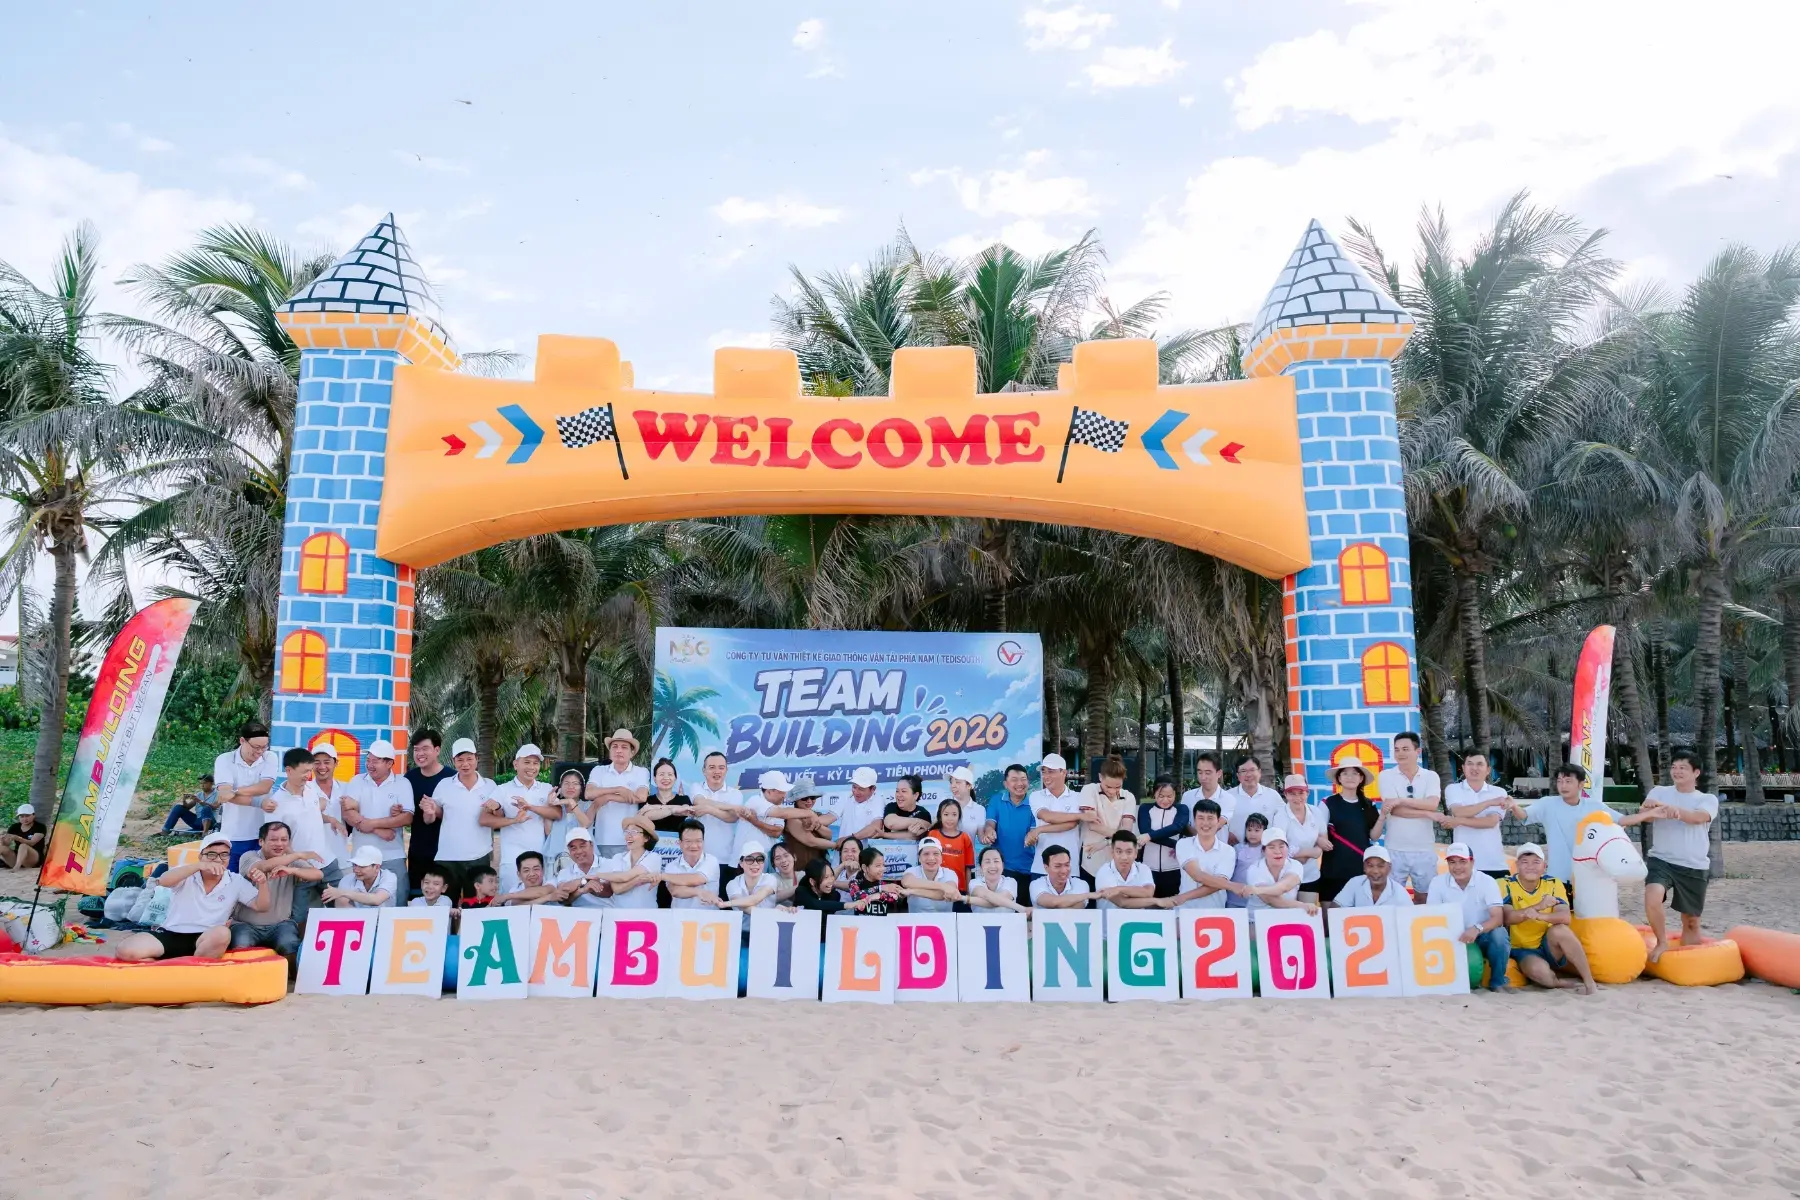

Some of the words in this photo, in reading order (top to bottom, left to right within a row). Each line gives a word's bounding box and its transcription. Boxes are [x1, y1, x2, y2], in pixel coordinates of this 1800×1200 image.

[632, 410, 1046, 470] WELCOME
[725, 649, 747, 660] CÔNG
[748, 651, 759, 660] TY
[824, 652, 841, 662] GIAO
[918, 653, 935, 663] NAM
[125, 714, 138, 738] BUT
[141, 670, 153, 695] CAN
[755, 668, 906, 717] TEAM
[64, 635, 147, 876] TEAMBUILDING
[727, 714, 923, 763] BUILDING
[925, 713, 1008, 756] 2026
[886, 764, 911, 778] TIÊN
[913, 764, 954, 777] PHONG
[866, 903, 888, 914] VELY
